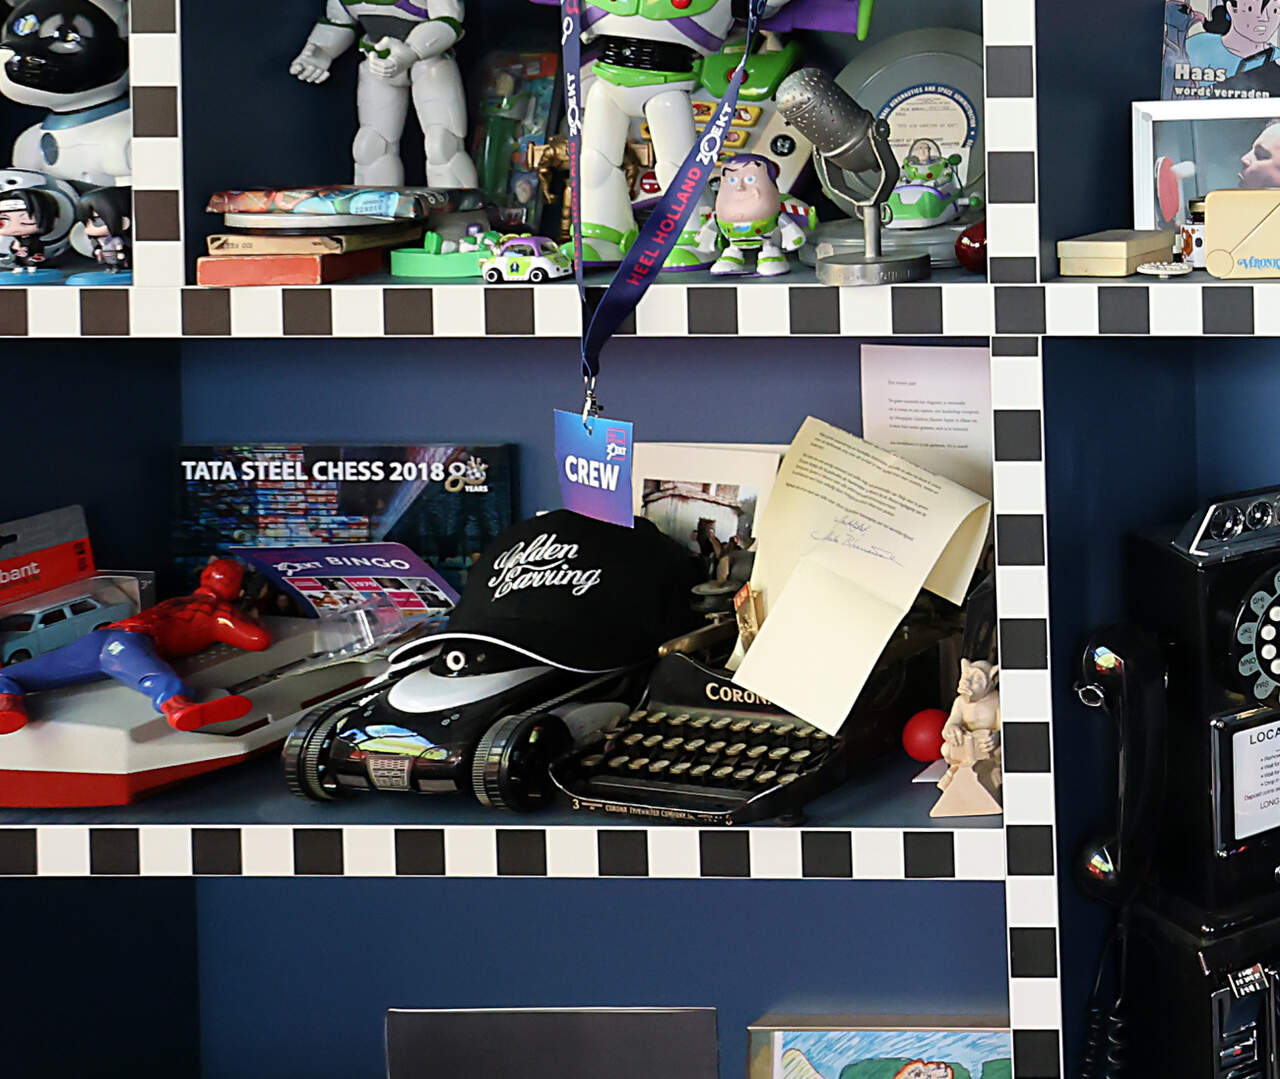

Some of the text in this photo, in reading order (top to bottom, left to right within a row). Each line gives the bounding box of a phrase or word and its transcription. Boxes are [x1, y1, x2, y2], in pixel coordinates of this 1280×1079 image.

[1174, 63, 1227, 82] Haas
[1174, 85, 1270, 99] wordt verraden
[696, 102, 734, 166] ZOEKT
[626, 167, 704, 286] HEEL HOLLAND
[181, 461, 445, 481] TATA STEEL CHESS 2018
[564, 455, 620, 492] CREW
[325, 556, 411, 570] BINGO
[488, 533, 579, 588] Golden
[705, 682, 772, 705] CORON
[572, 798, 581, 810] 3
[1259, 797, 1279, 810] LONG
